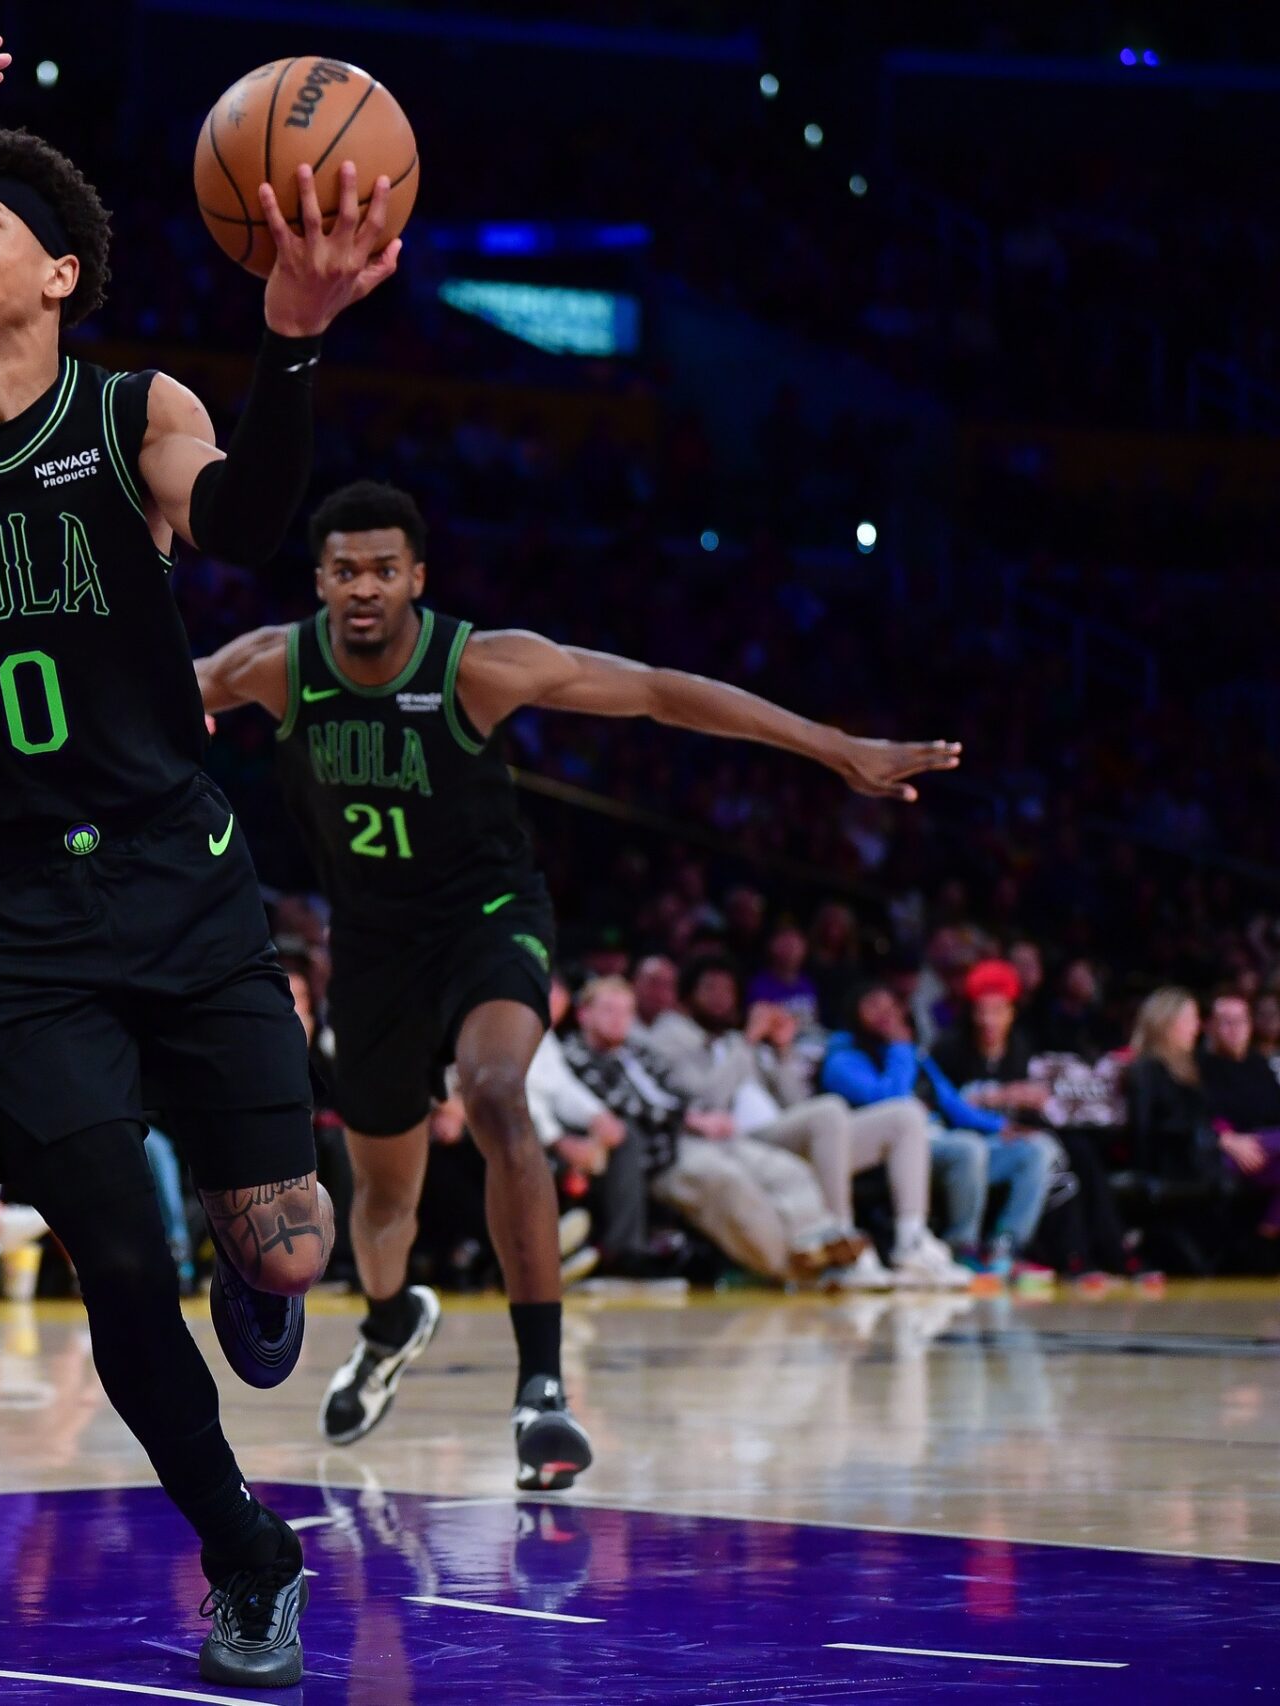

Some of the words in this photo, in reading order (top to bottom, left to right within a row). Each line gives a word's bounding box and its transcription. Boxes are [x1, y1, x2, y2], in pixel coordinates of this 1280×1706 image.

[33, 447, 101, 479] NEWAGE
[43, 465, 97, 489] PRODUCTS
[308, 720, 433, 797] NOLA
[344, 803, 413, 858] 21
